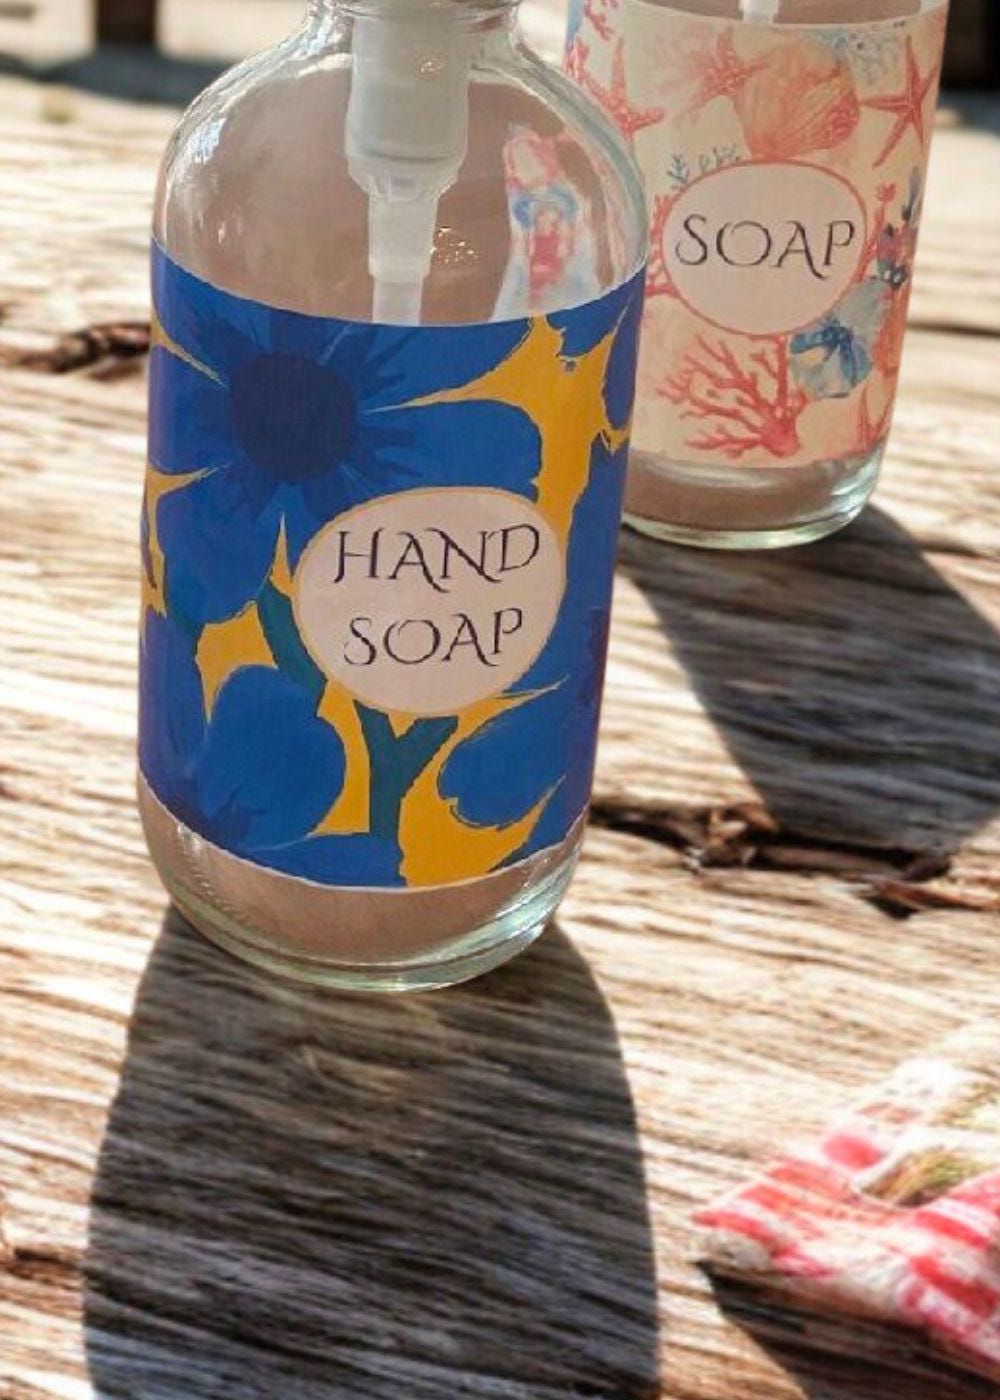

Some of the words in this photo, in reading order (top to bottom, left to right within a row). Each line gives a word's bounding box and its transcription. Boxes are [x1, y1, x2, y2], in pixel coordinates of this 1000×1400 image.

[675, 213, 856, 280] SOAP
[333, 522, 541, 594] HAND
[342, 606, 524, 667] SOAP
